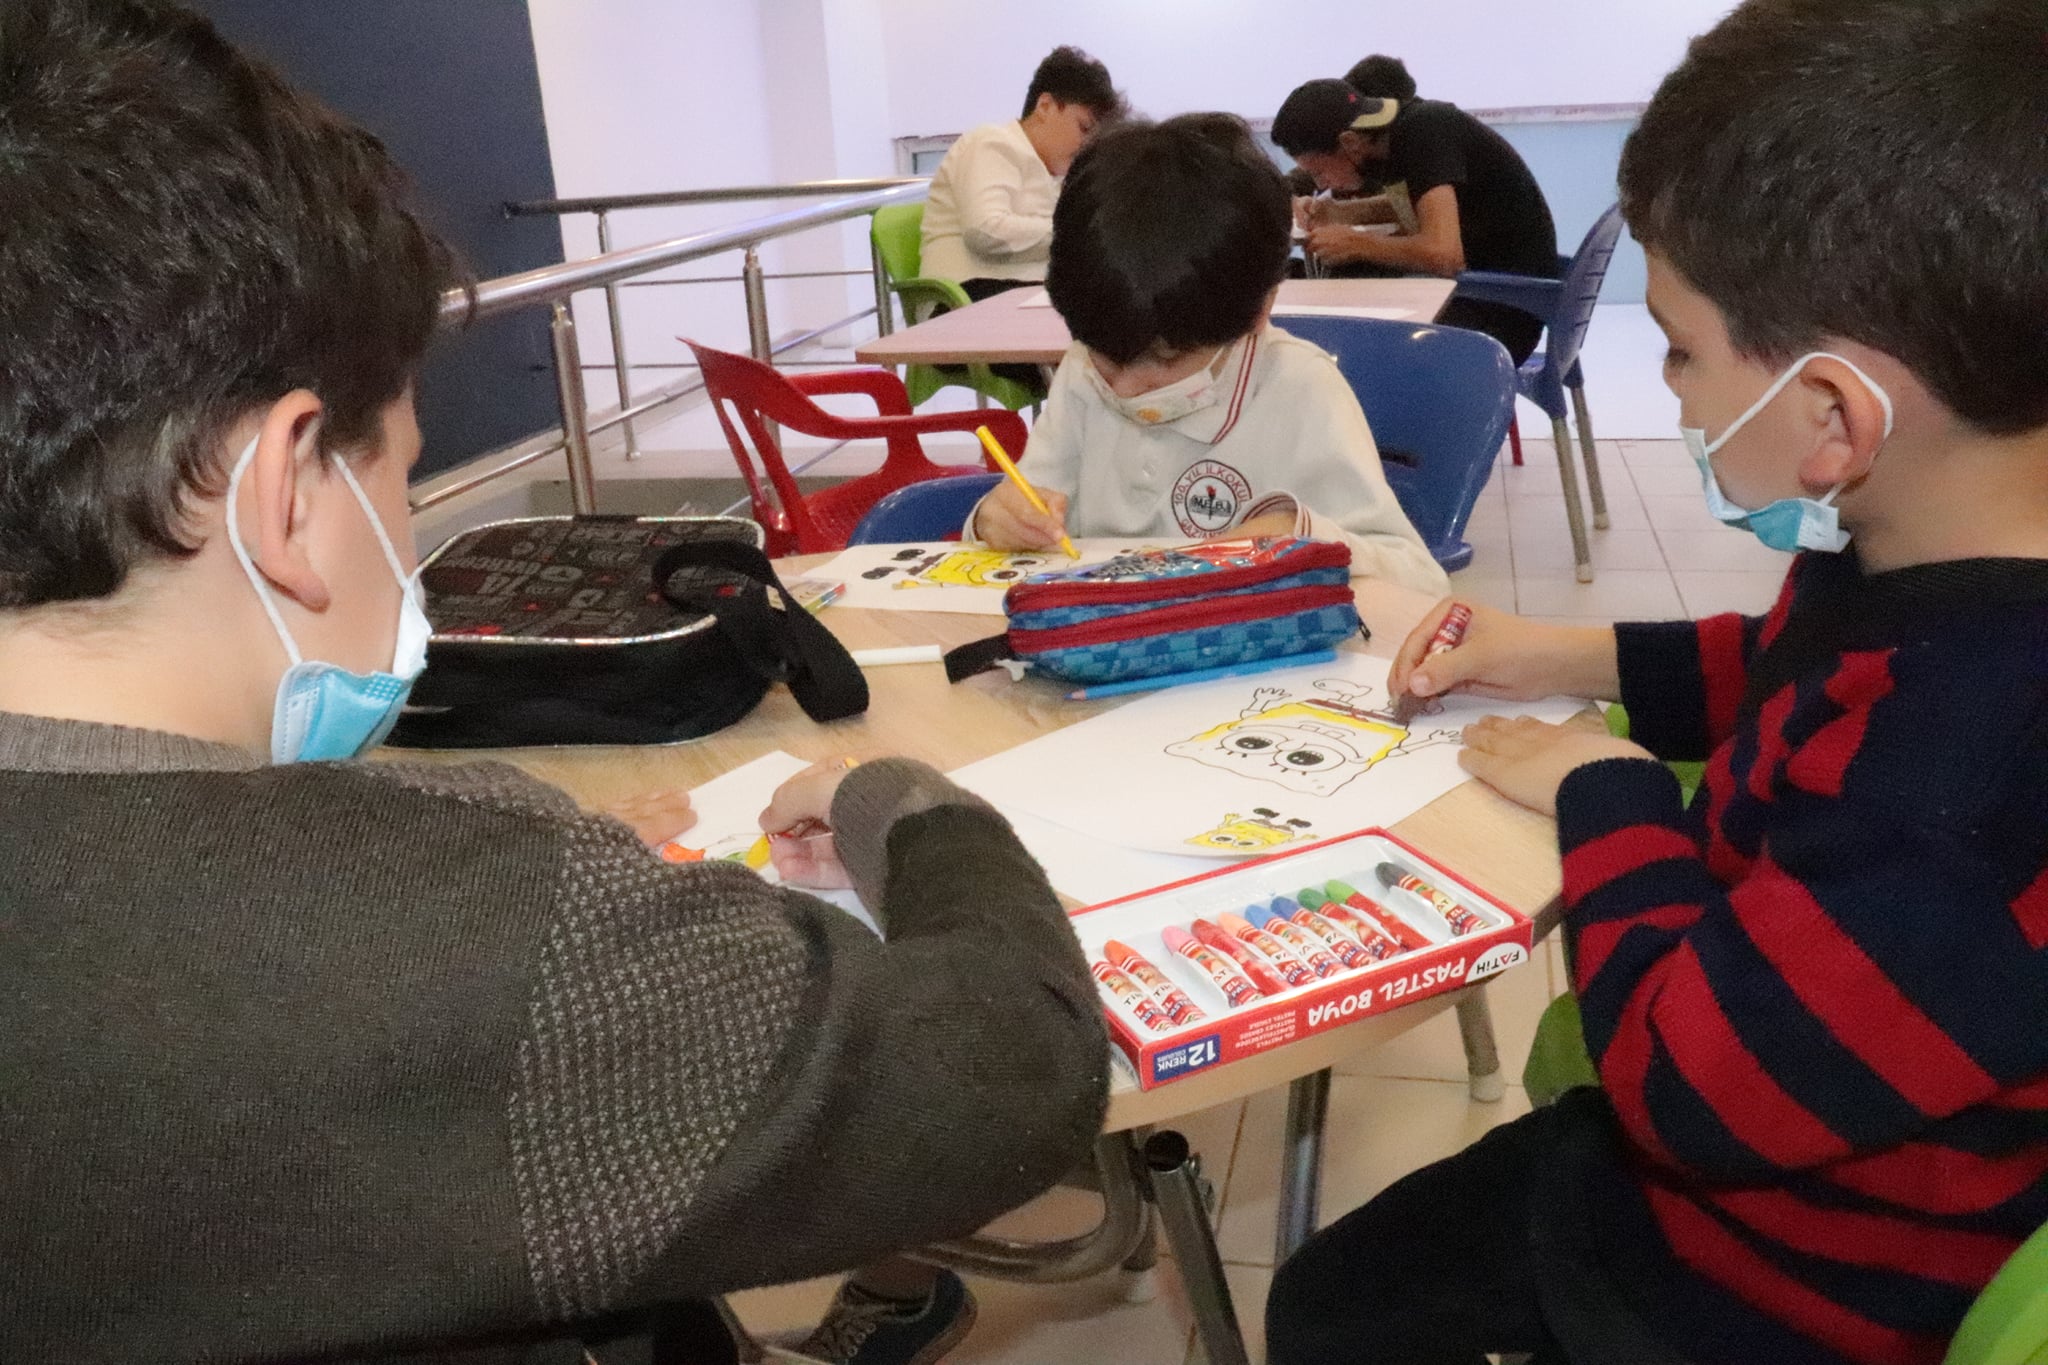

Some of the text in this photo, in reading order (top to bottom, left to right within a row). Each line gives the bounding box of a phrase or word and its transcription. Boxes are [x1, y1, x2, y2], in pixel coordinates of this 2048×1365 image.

[1307, 958, 1467, 1026] PASTEL BOYA
[1157, 1055, 1187, 1072] RENK
[1187, 1040, 1217, 1067] 12
